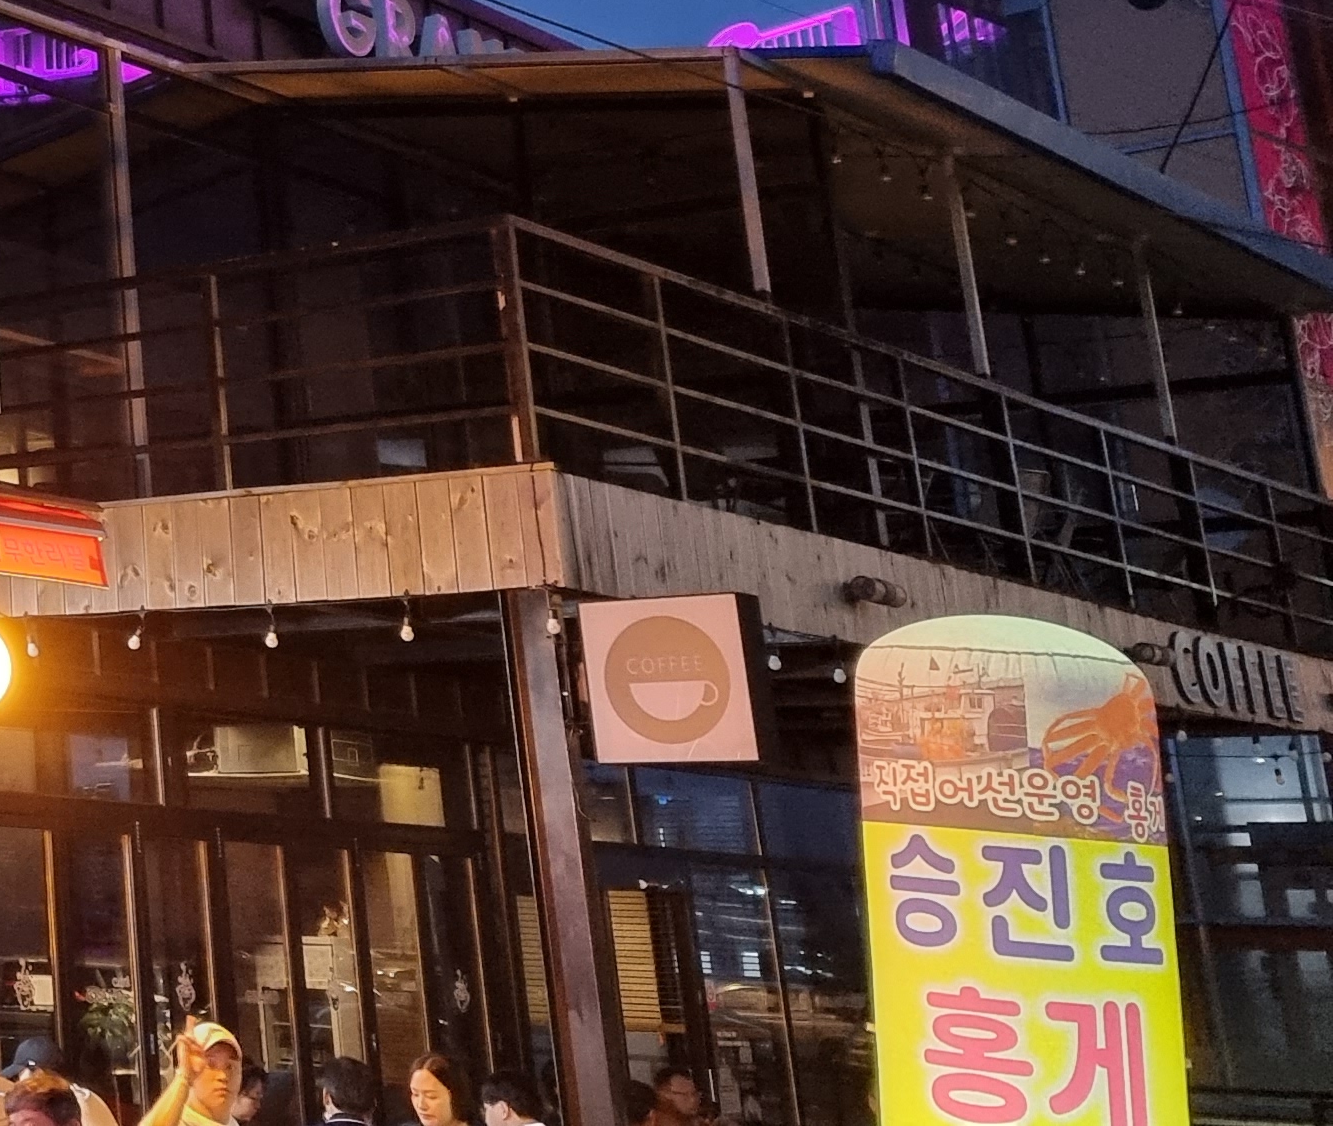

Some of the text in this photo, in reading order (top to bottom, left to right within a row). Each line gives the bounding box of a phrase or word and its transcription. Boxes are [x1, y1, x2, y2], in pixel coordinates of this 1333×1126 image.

[3, 537, 88, 572] 무한리필
[625, 654, 704, 675] COFFEE
[1171, 631, 1305, 723] COFFEE
[874, 760, 1099, 824] 직접 어선운영
[889, 834, 1164, 965] 승진호
[924, 986, 1149, 1126] 홍게
